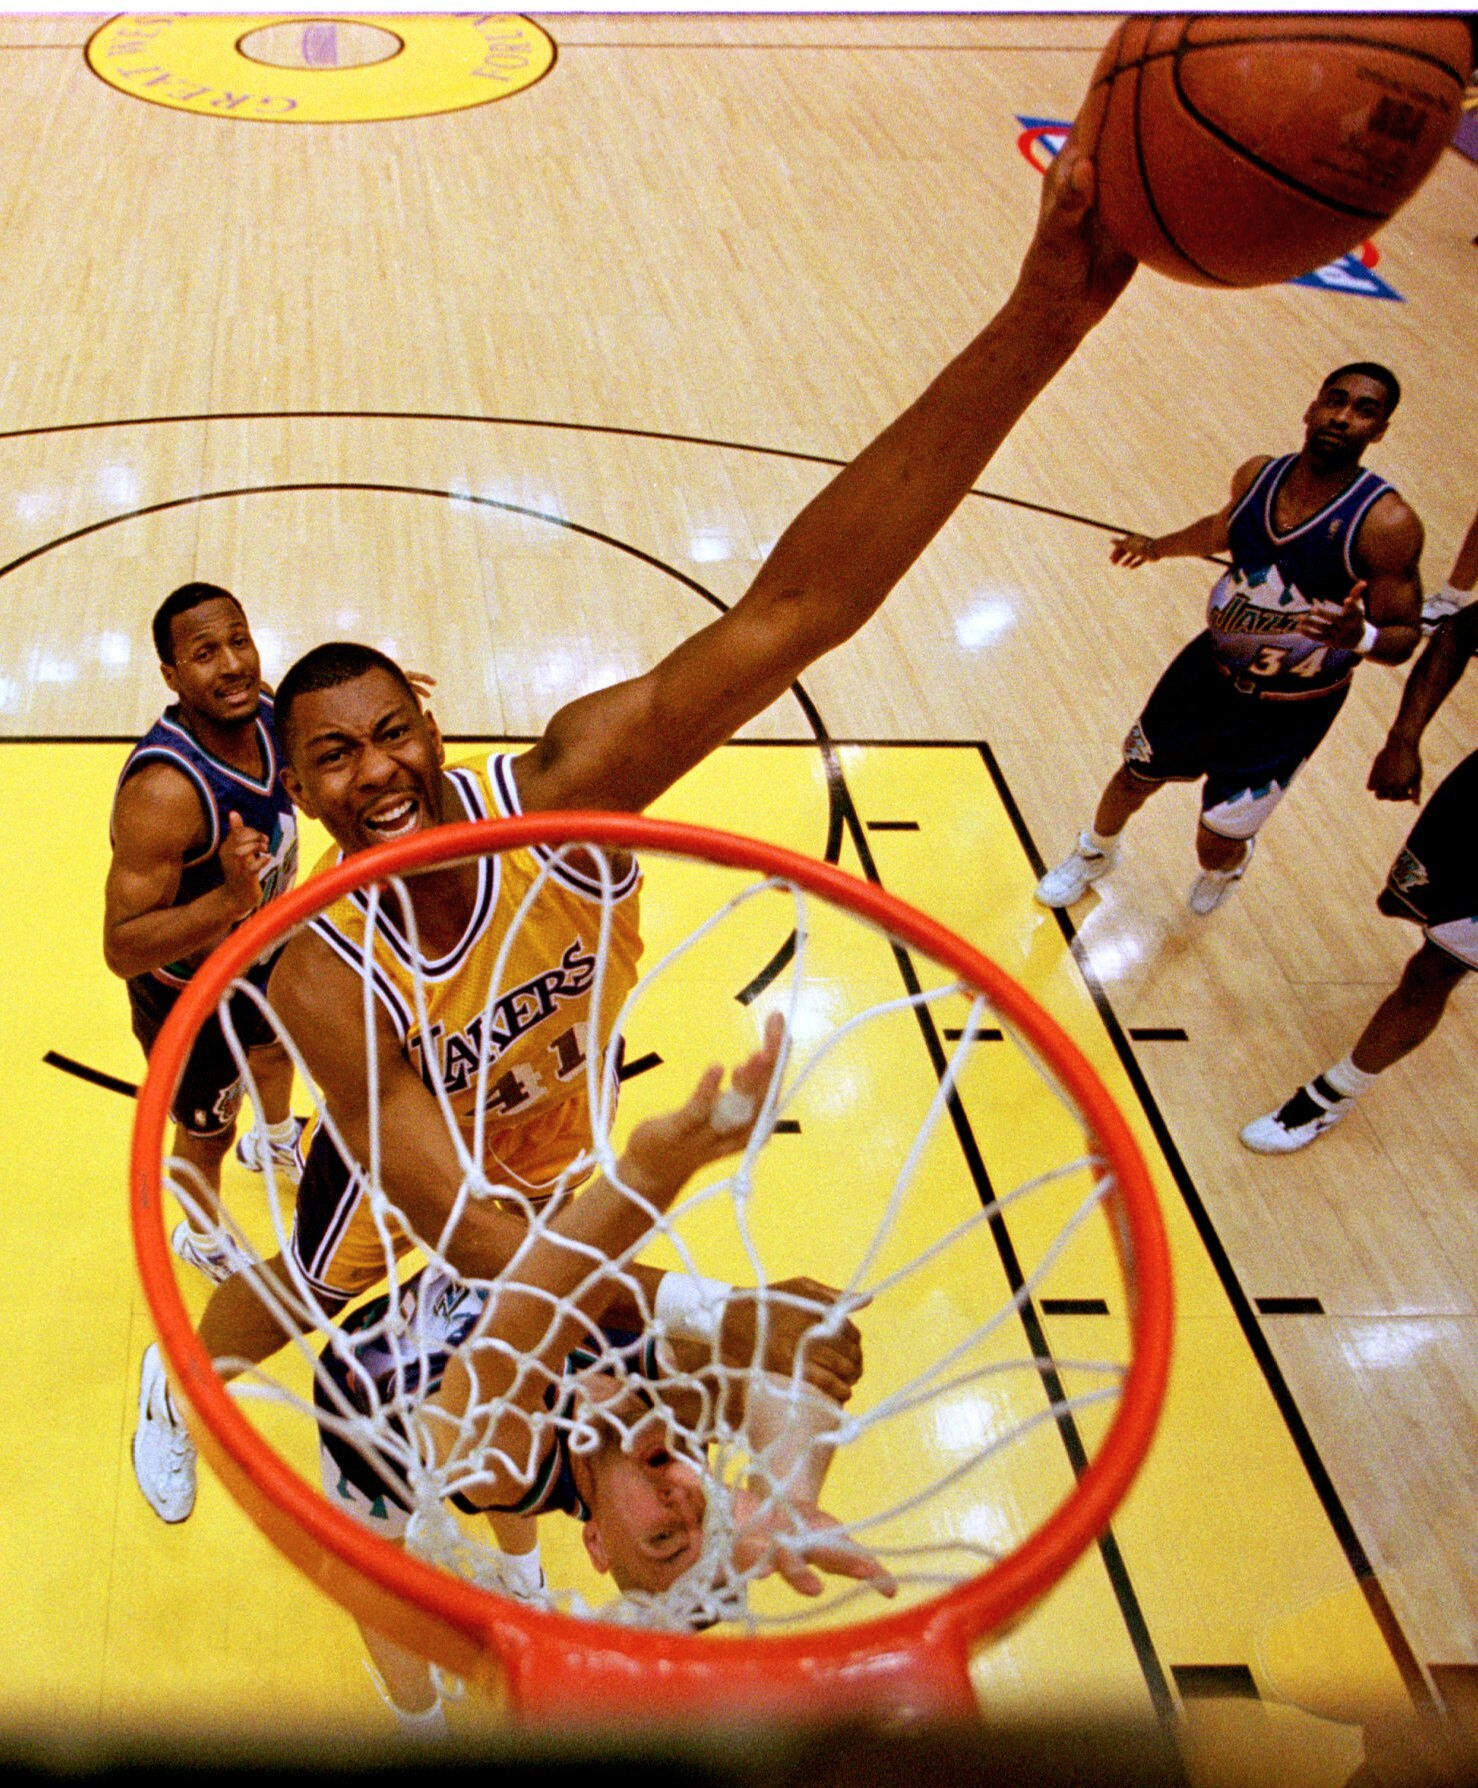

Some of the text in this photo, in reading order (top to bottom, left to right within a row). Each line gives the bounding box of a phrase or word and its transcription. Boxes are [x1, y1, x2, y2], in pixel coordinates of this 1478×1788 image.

[106, 14, 299, 115] GREAT WES
[1247, 645, 1330, 679] 34
[407, 934, 599, 1099] LAKERS
[463, 1022, 594, 1117] 41
